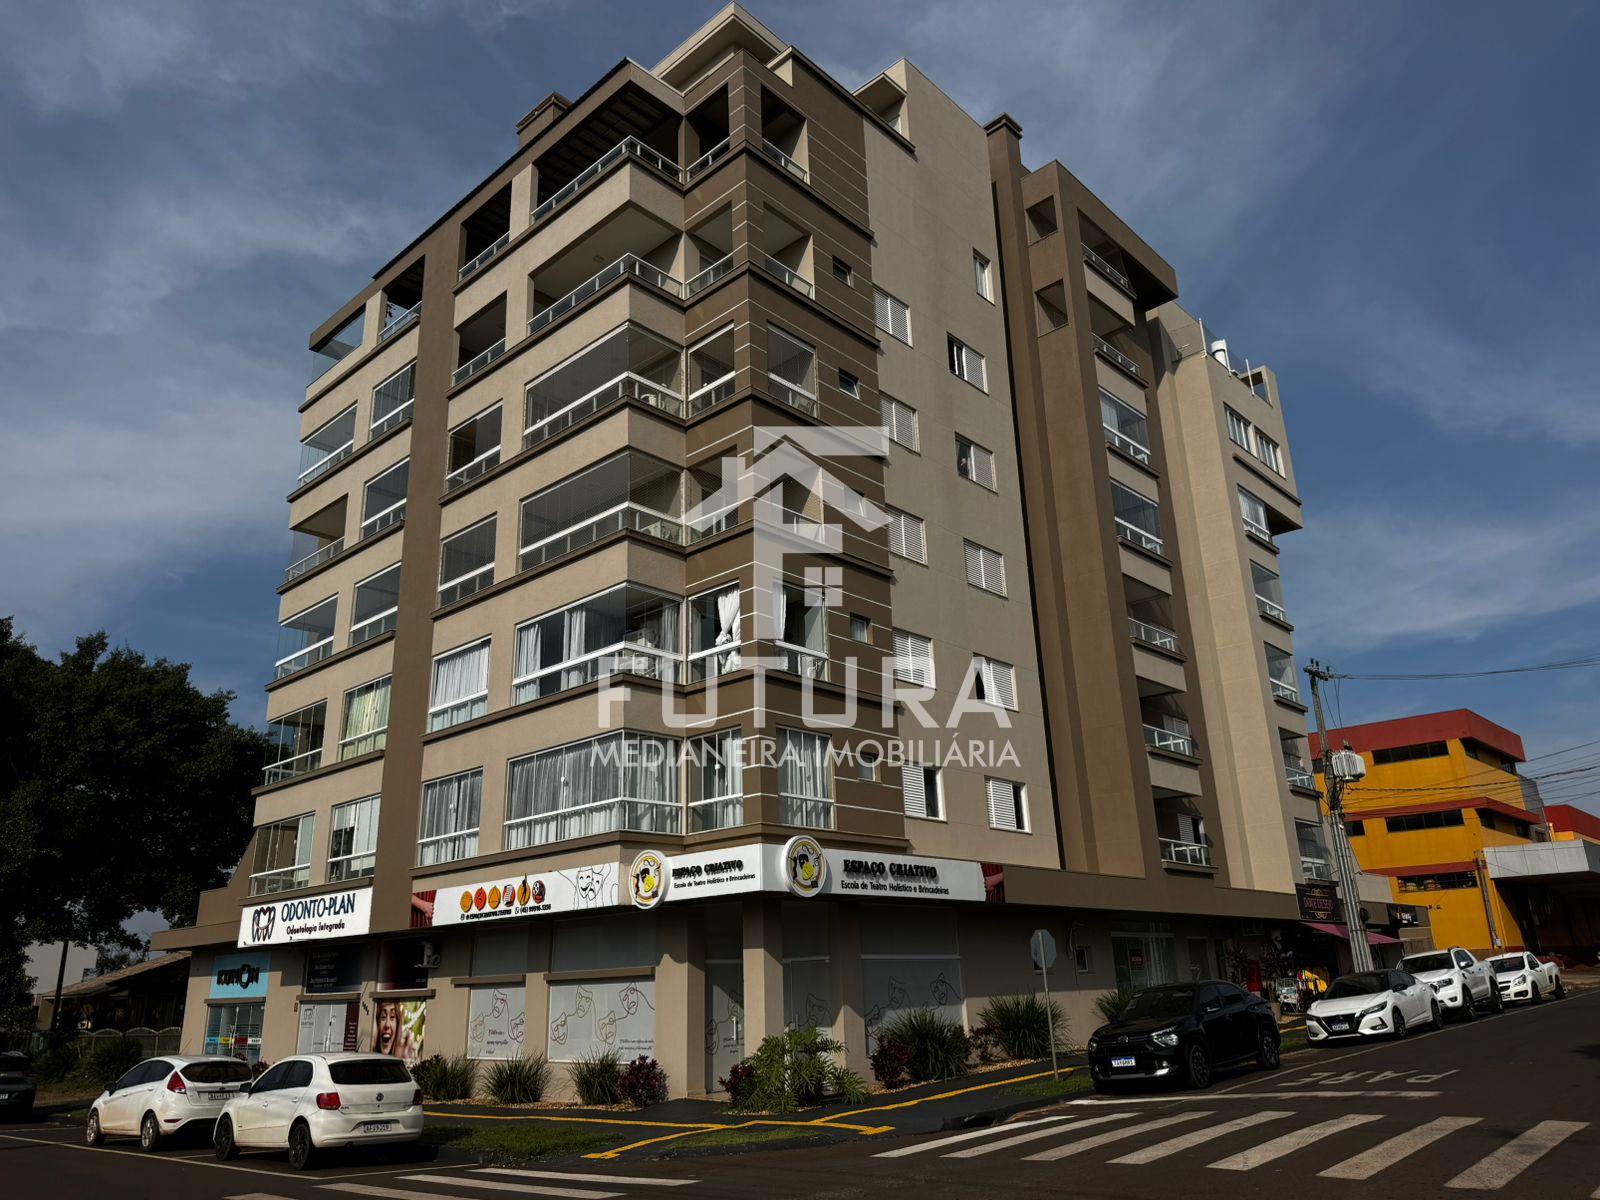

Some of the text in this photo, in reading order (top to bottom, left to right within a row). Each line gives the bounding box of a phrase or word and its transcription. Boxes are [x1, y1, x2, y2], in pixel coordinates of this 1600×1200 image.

[843, 859, 937, 879] ESPAÇO CRIATIVO
[841, 880, 859, 889] Escola
[861, 881, 868, 889] de
[869, 881, 887, 891] Teatro
[918, 885, 949, 895] Brincadeiras
[281, 893, 356, 922] ODONTO-PLAN
[287, 920, 345, 935] Odontologia integrada
